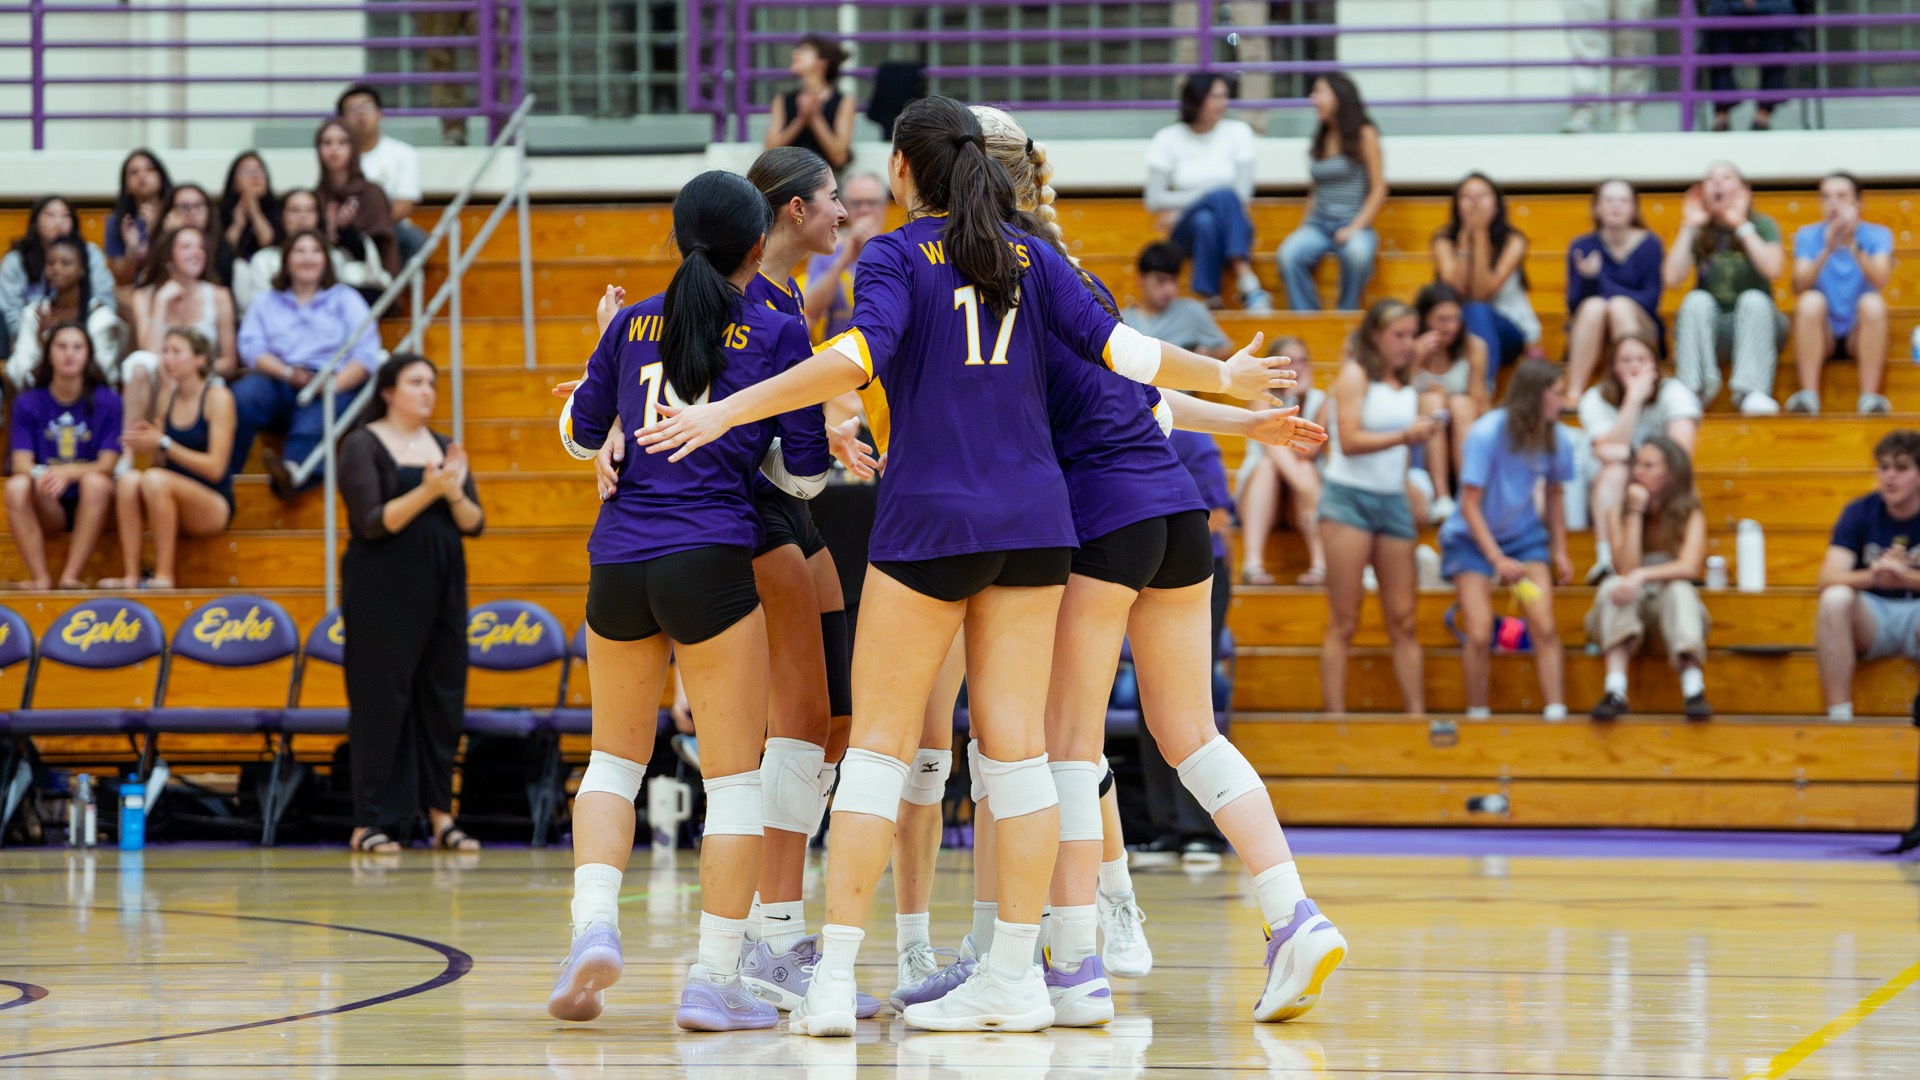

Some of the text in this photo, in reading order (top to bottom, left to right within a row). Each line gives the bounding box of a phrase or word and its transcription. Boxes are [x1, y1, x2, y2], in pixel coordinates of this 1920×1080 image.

[954, 284, 1021, 365] 17
[62, 608, 141, 652] Ephs
[193, 606, 274, 650] Ephs
[466, 611, 543, 654] Ephs
